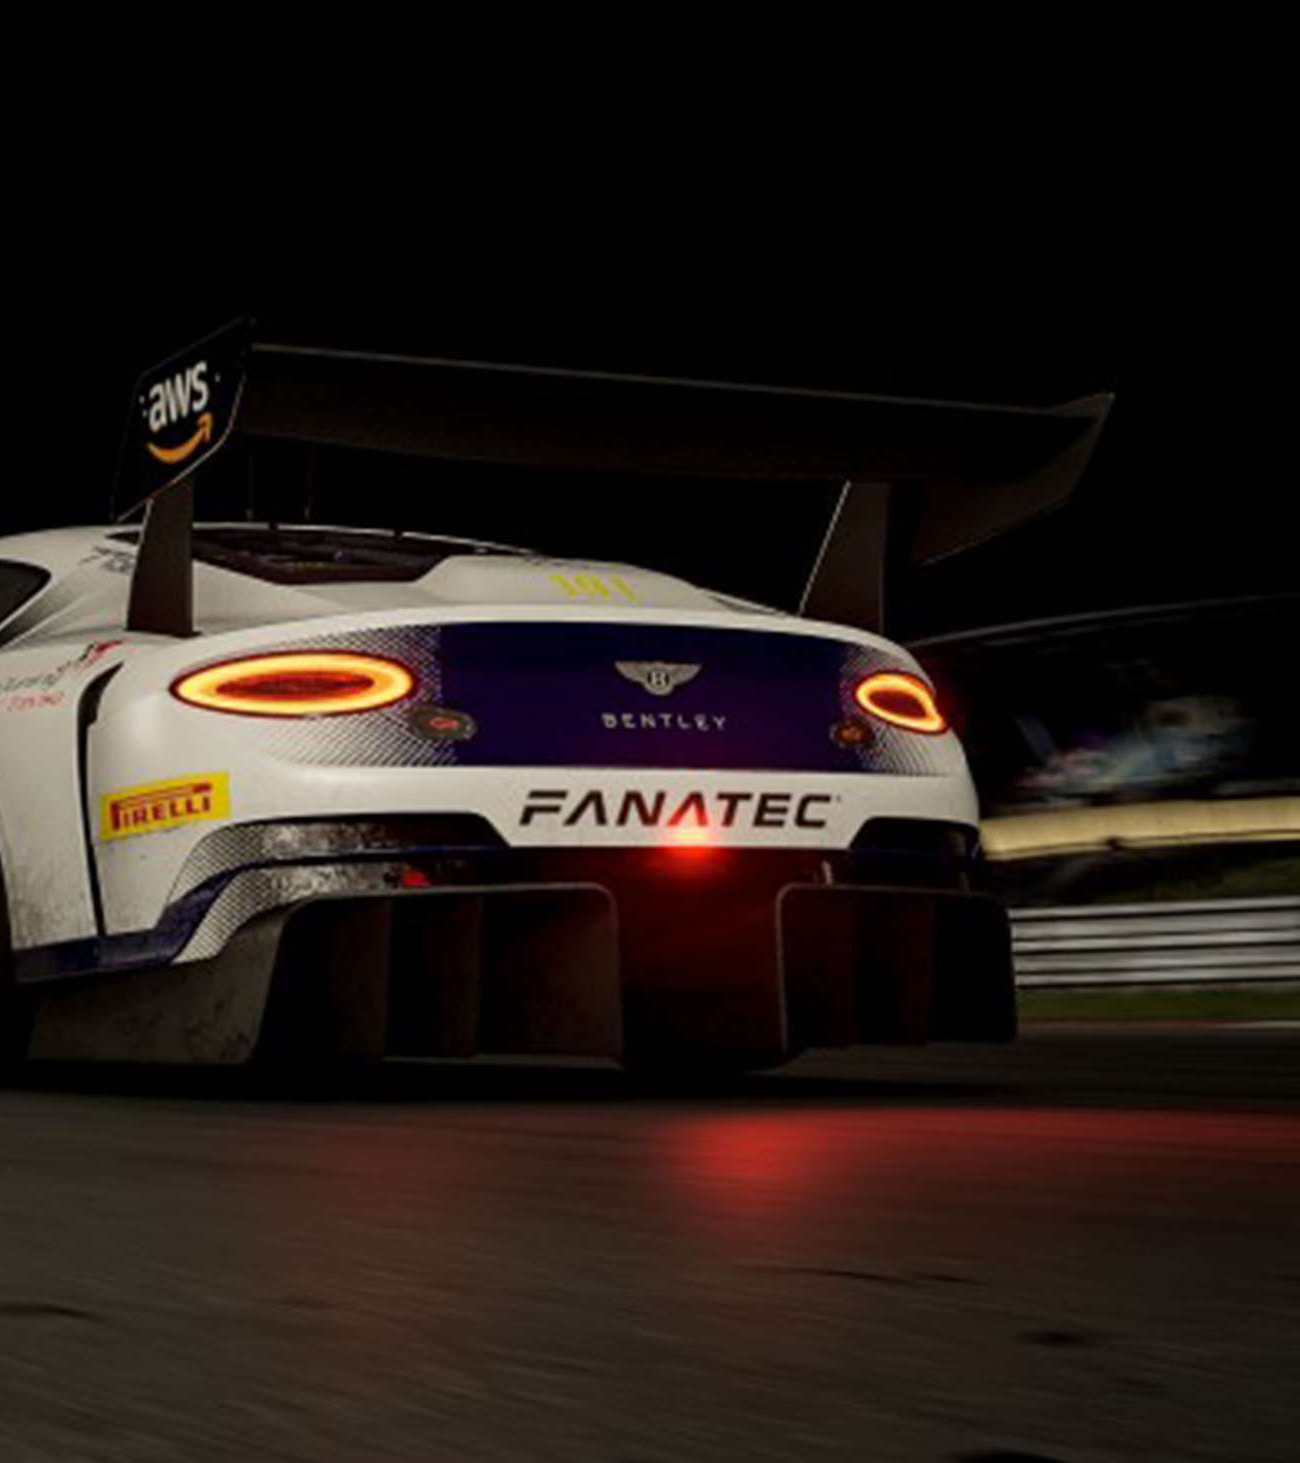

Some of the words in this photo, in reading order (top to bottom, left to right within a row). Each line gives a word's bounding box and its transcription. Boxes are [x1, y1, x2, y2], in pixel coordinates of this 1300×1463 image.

[148, 359, 211, 434] aws
[601, 712, 726, 732] BENTLEY
[109, 782, 213, 832] PIRELLI
[518, 790, 836, 831] FANATEC
